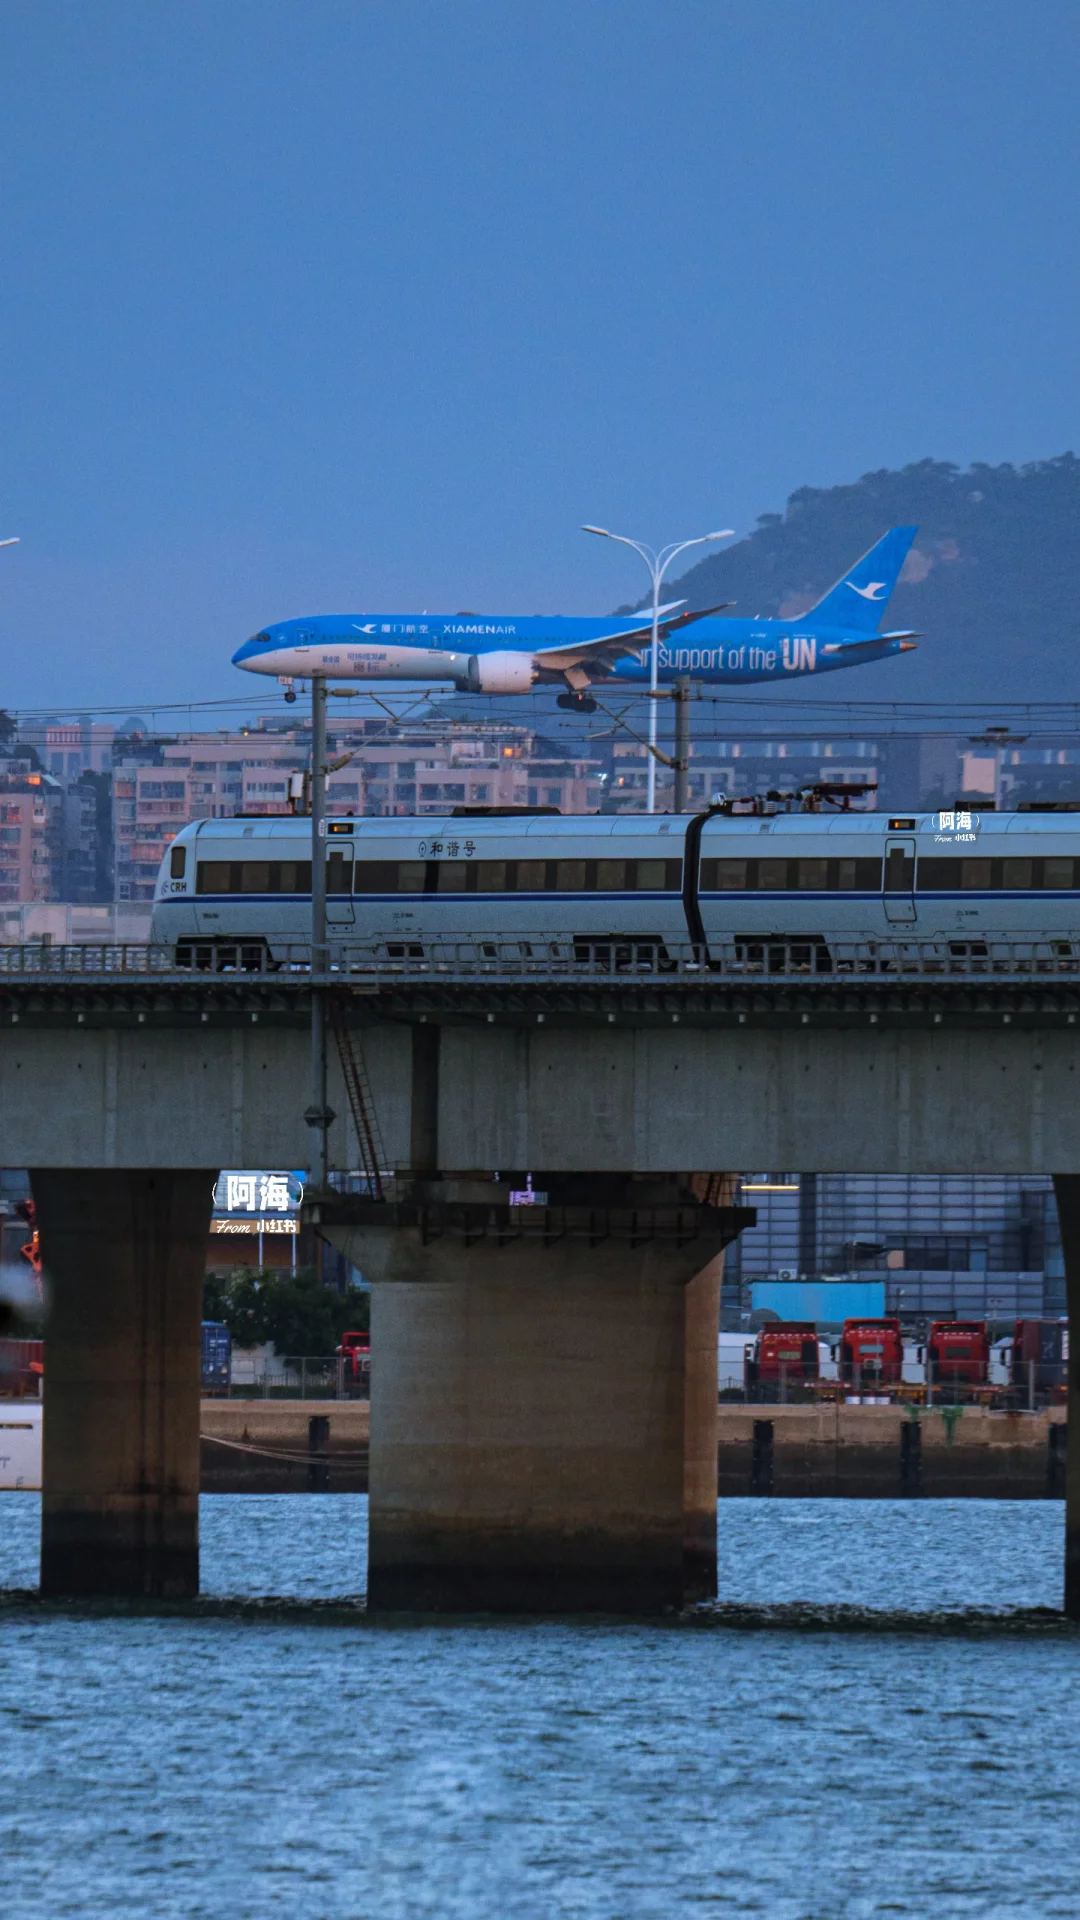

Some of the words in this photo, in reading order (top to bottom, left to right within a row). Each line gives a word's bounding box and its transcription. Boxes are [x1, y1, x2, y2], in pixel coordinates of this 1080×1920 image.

[658, 645, 724, 671] support
[728, 645, 746, 669] of
[750, 646, 777, 670] the
[782, 638, 816, 670] UN
[429, 840, 476, 858] 和谐号
[170, 882, 187, 893] CRH
